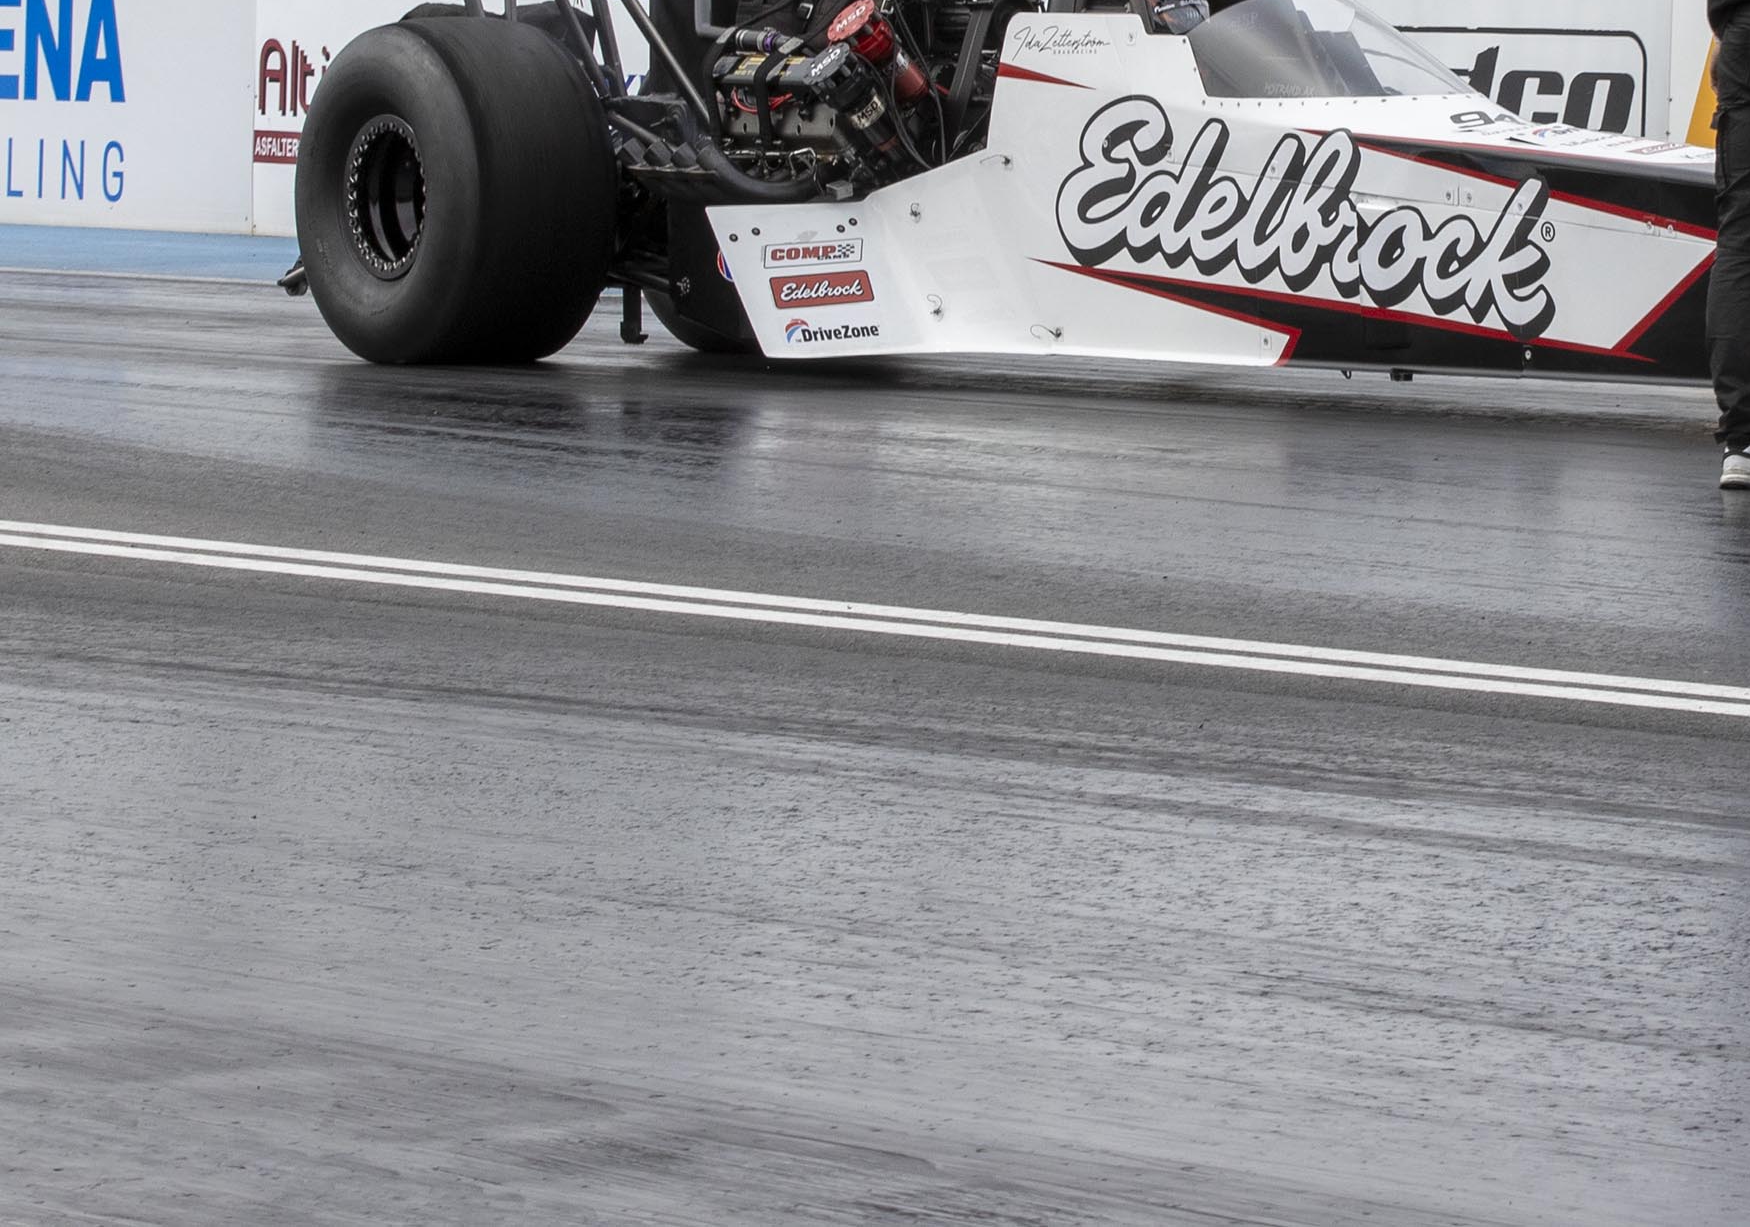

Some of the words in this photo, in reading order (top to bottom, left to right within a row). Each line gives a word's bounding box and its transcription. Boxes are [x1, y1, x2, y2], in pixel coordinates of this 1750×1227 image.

[835, 5, 866, 32] MSD
[811, 48, 841, 77] MSD
[857, 99, 879, 124] MSD
[1056, 94, 1556, 341] Edelbrock
[770, 245, 837, 261] COMP
[780, 278, 864, 302] Edelbrock
[801, 325, 880, 343] DriveZone
